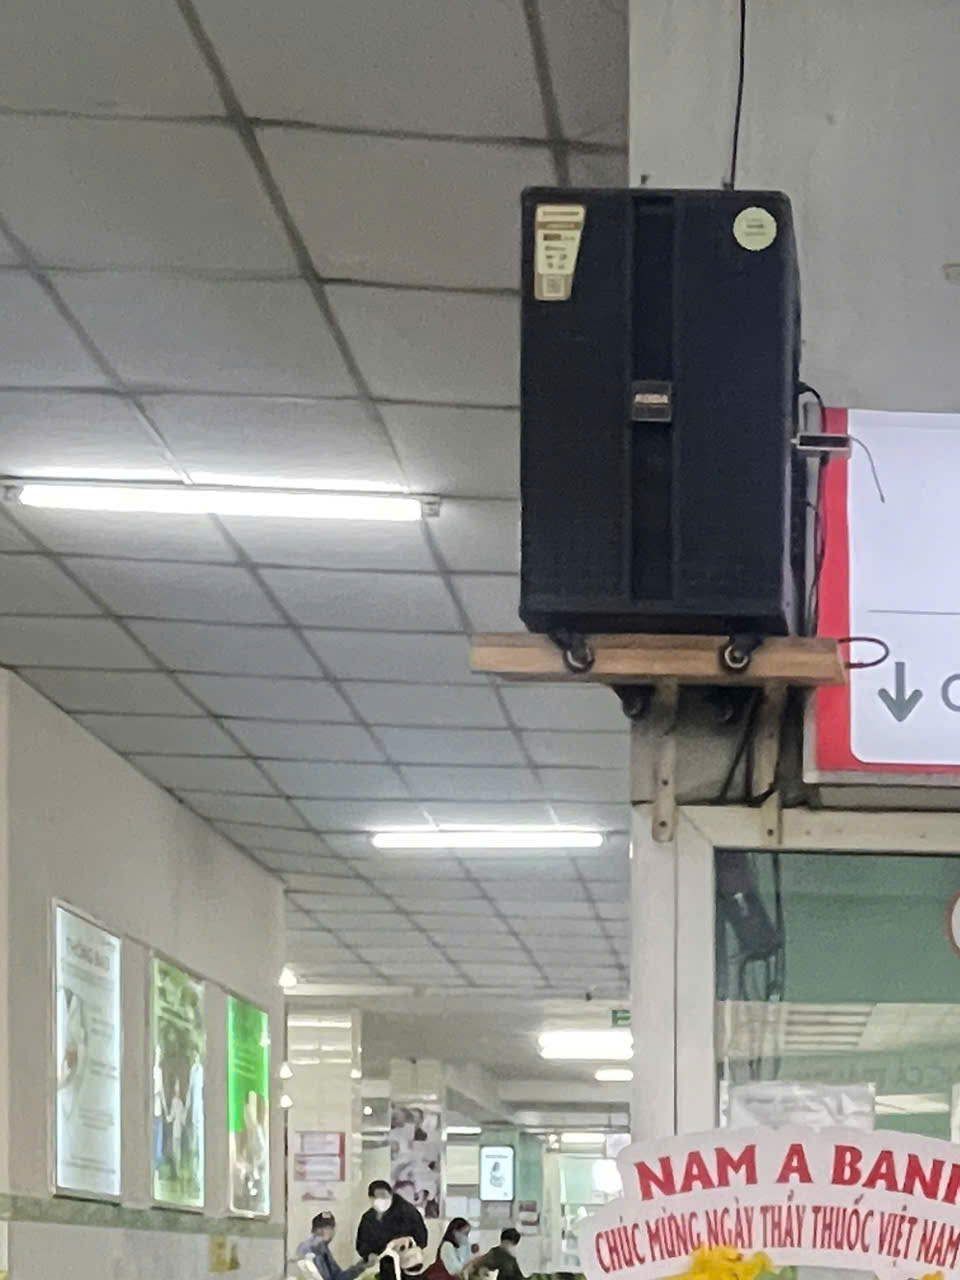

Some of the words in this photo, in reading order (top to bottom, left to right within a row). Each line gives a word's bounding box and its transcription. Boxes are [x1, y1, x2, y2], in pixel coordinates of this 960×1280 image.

[634, 1144, 758, 1201] NAM
[776, 1143, 813, 1184] A
[595, 1215, 646, 1273] CHÚC
[645, 1206, 701, 1262] MỪNG
[705, 1196, 755, 1251] NGÀY
[812, 1193, 874, 1252] THUỐC
[878, 1204, 918, 1267] VIỆT
